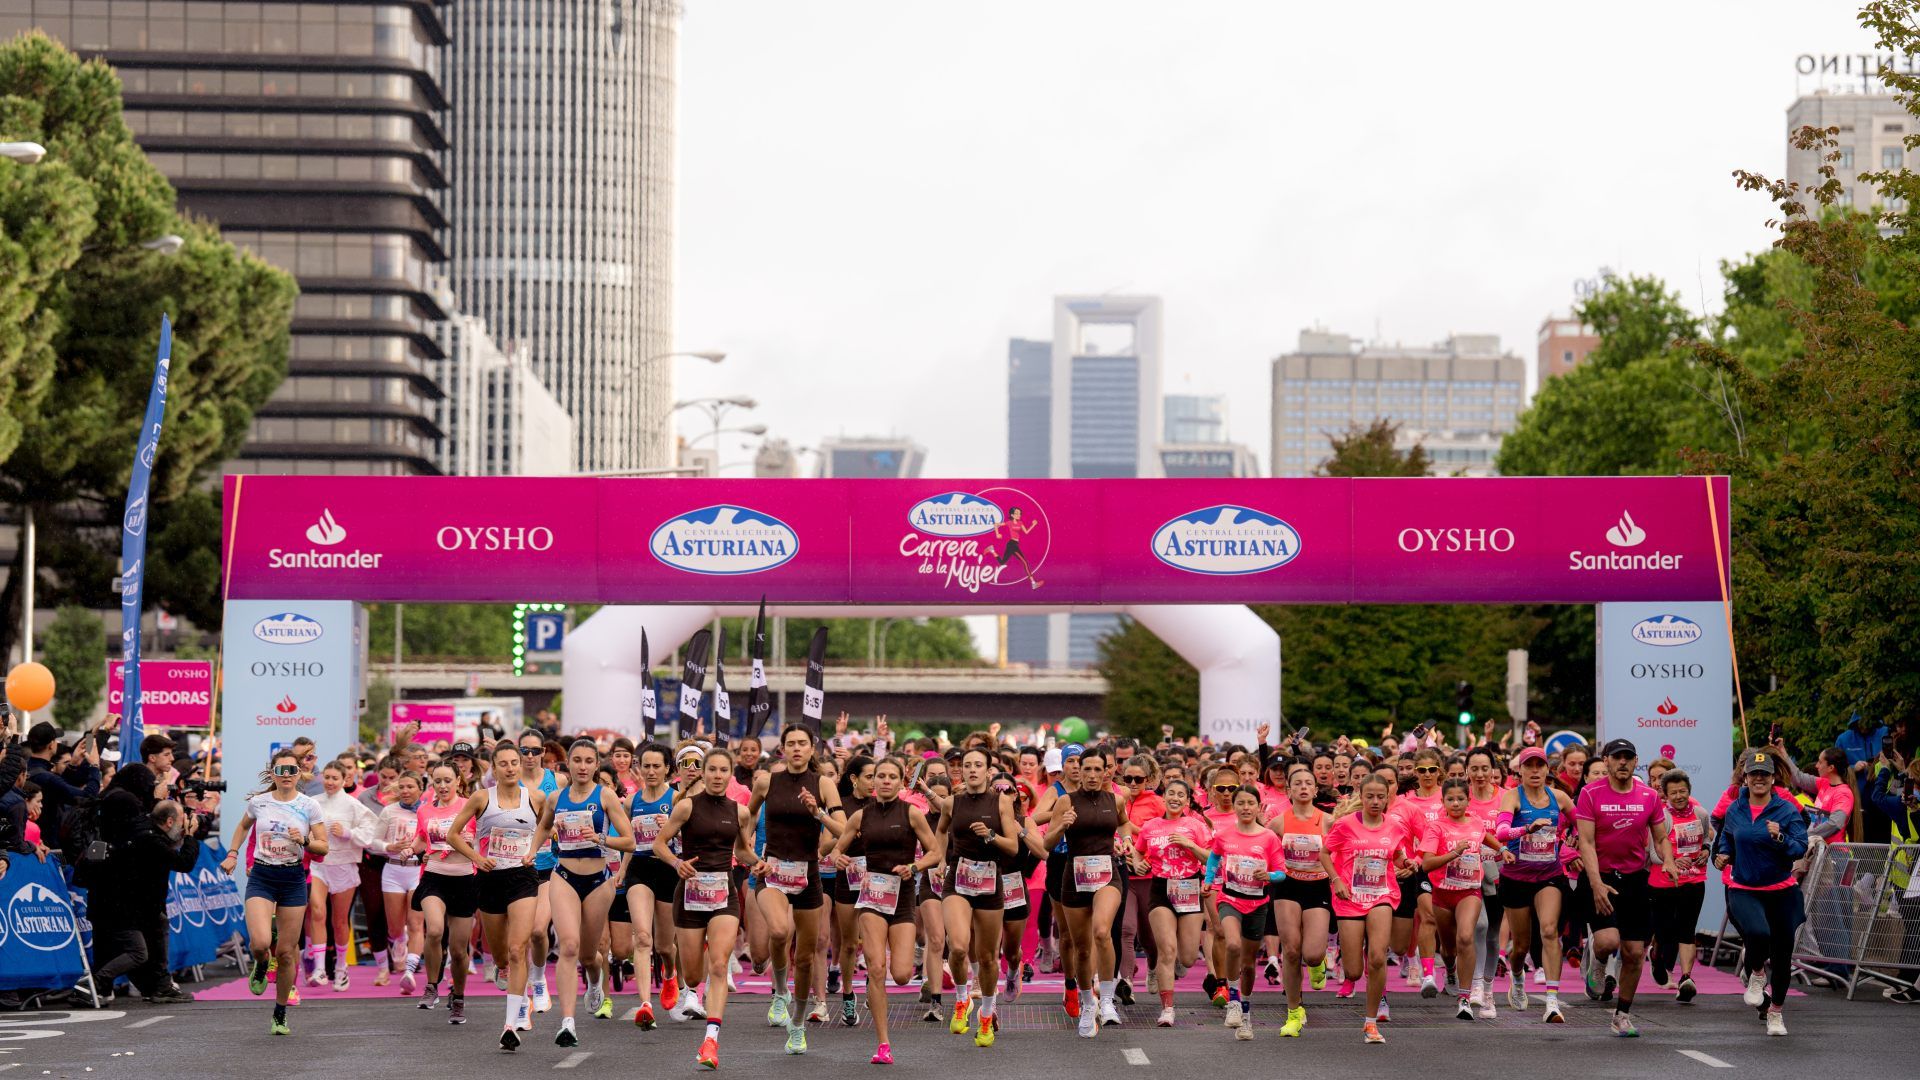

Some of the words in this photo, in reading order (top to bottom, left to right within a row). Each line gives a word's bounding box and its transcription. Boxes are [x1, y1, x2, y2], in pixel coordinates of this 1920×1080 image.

[916, 508, 996, 526] ASTURIANA
[436, 526, 554, 551] OYSHO
[661, 530, 788, 556] ASTURIANA
[900, 533, 979, 557] Carrera
[1164, 530, 1290, 556] ASTURIANA
[1398, 528, 1515, 552] OYSHO
[268, 548, 383, 568] Santander
[1569, 550, 1683, 570] Santander
[918, 557, 934, 574] de
[936, 556, 948, 574] la
[944, 555, 1008, 593] Mujer
[258, 624, 318, 637] ASTURIANA
[536, 619, 557, 650] P
[1637, 626, 1697, 639] ASTURIANA
[168, 668, 208, 679] OYSHO
[251, 662, 324, 677] OYSHO
[1631, 663, 1704, 679] OYSHO
[110, 691, 209, 705] CREDORAS
[256, 715, 316, 726] Santander
[1637, 717, 1698, 728] Santander
[1754, 753, 1766, 763] B
[1600, 804, 1644, 812] SOLISS
[502, 844, 518, 852] 016
[699, 890, 716, 898] 016
[15, 908, 72, 933] ASTURIANA
